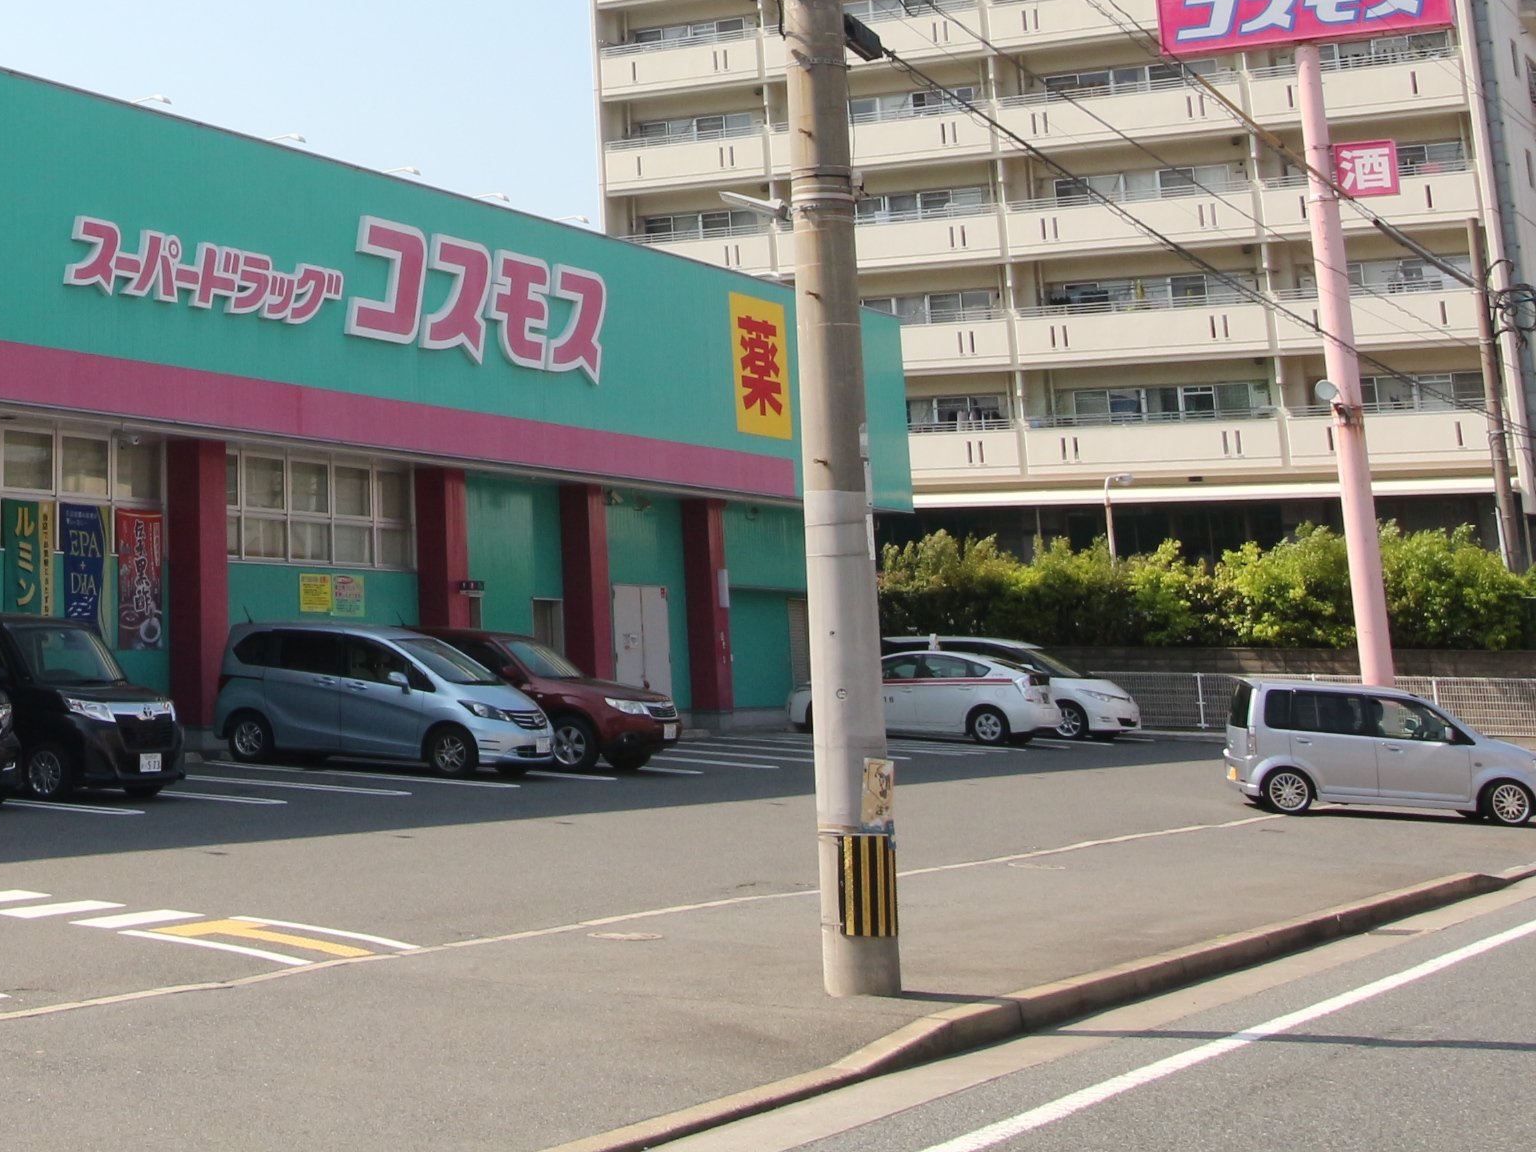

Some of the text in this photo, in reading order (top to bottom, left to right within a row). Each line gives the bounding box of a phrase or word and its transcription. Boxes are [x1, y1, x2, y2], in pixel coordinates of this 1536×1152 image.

[1339, 147, 1392, 190] 酒
[64, 215, 606, 385] スーパードラッグ コスモス
[737, 315, 783, 415] 薬
[69, 530, 102, 558] EPA
